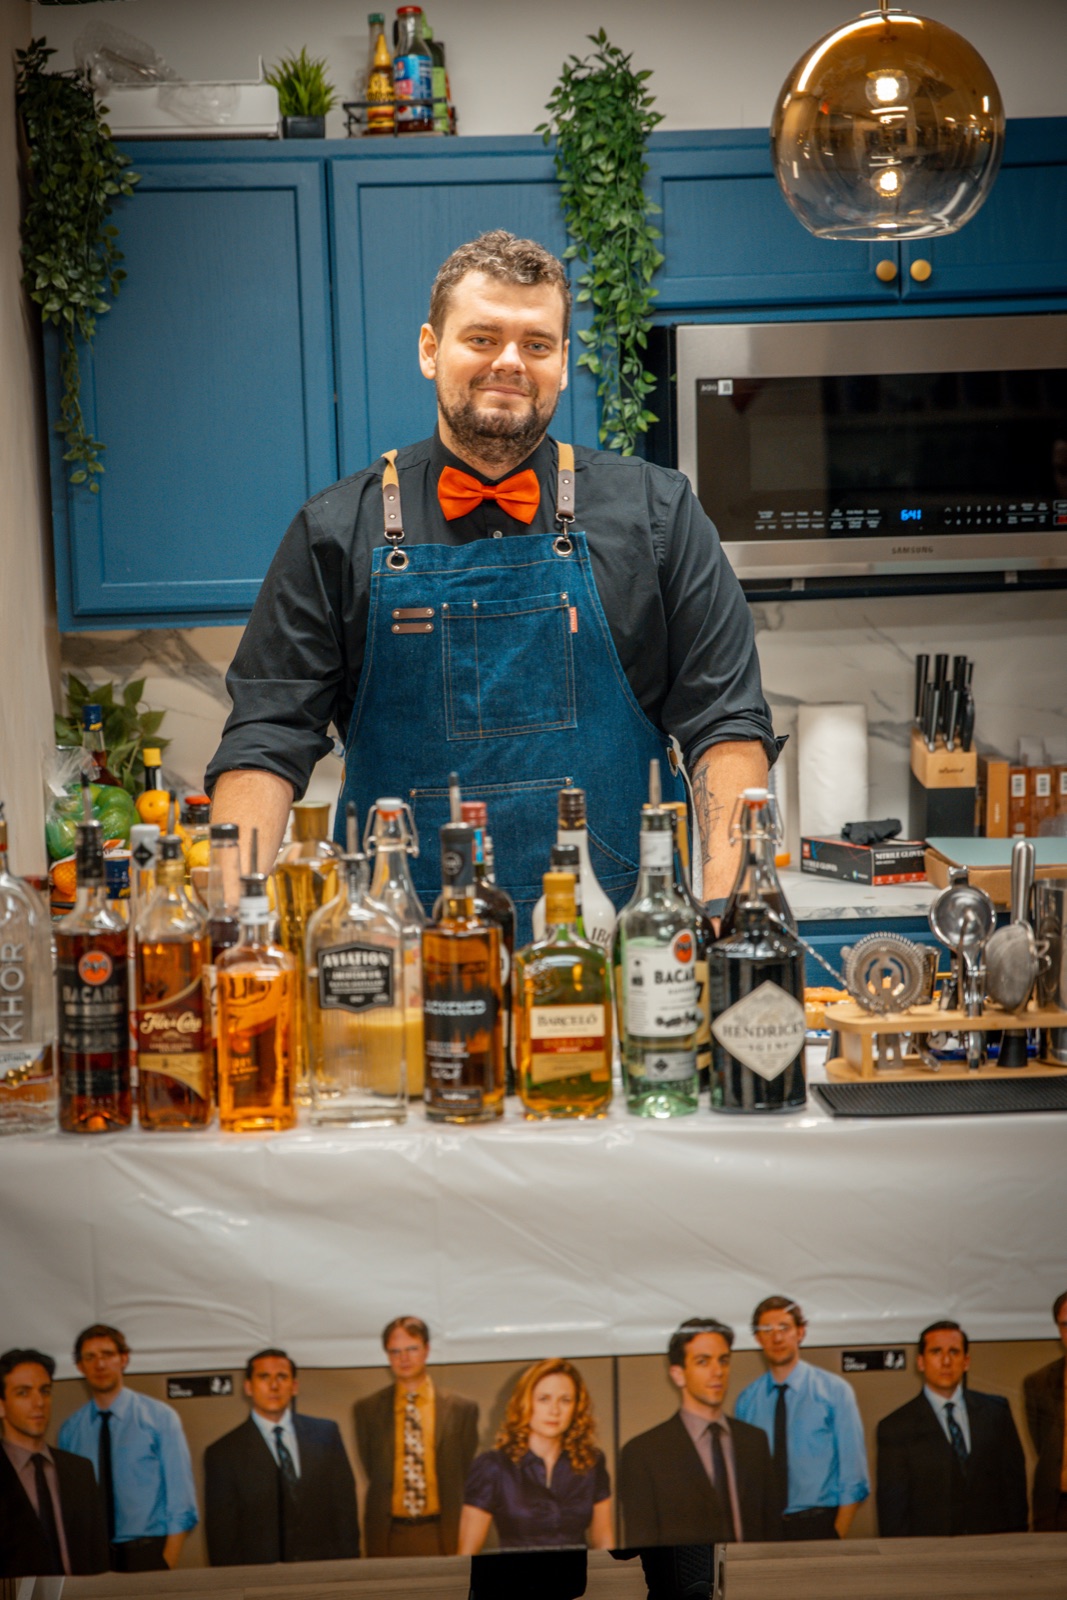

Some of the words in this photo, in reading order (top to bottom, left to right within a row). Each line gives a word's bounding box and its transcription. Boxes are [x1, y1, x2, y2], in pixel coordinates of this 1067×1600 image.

[891, 546, 934, 554] SAMSUNG
[322, 951, 390, 969] AVIATION
[0, 943, 25, 1042] KHOR
